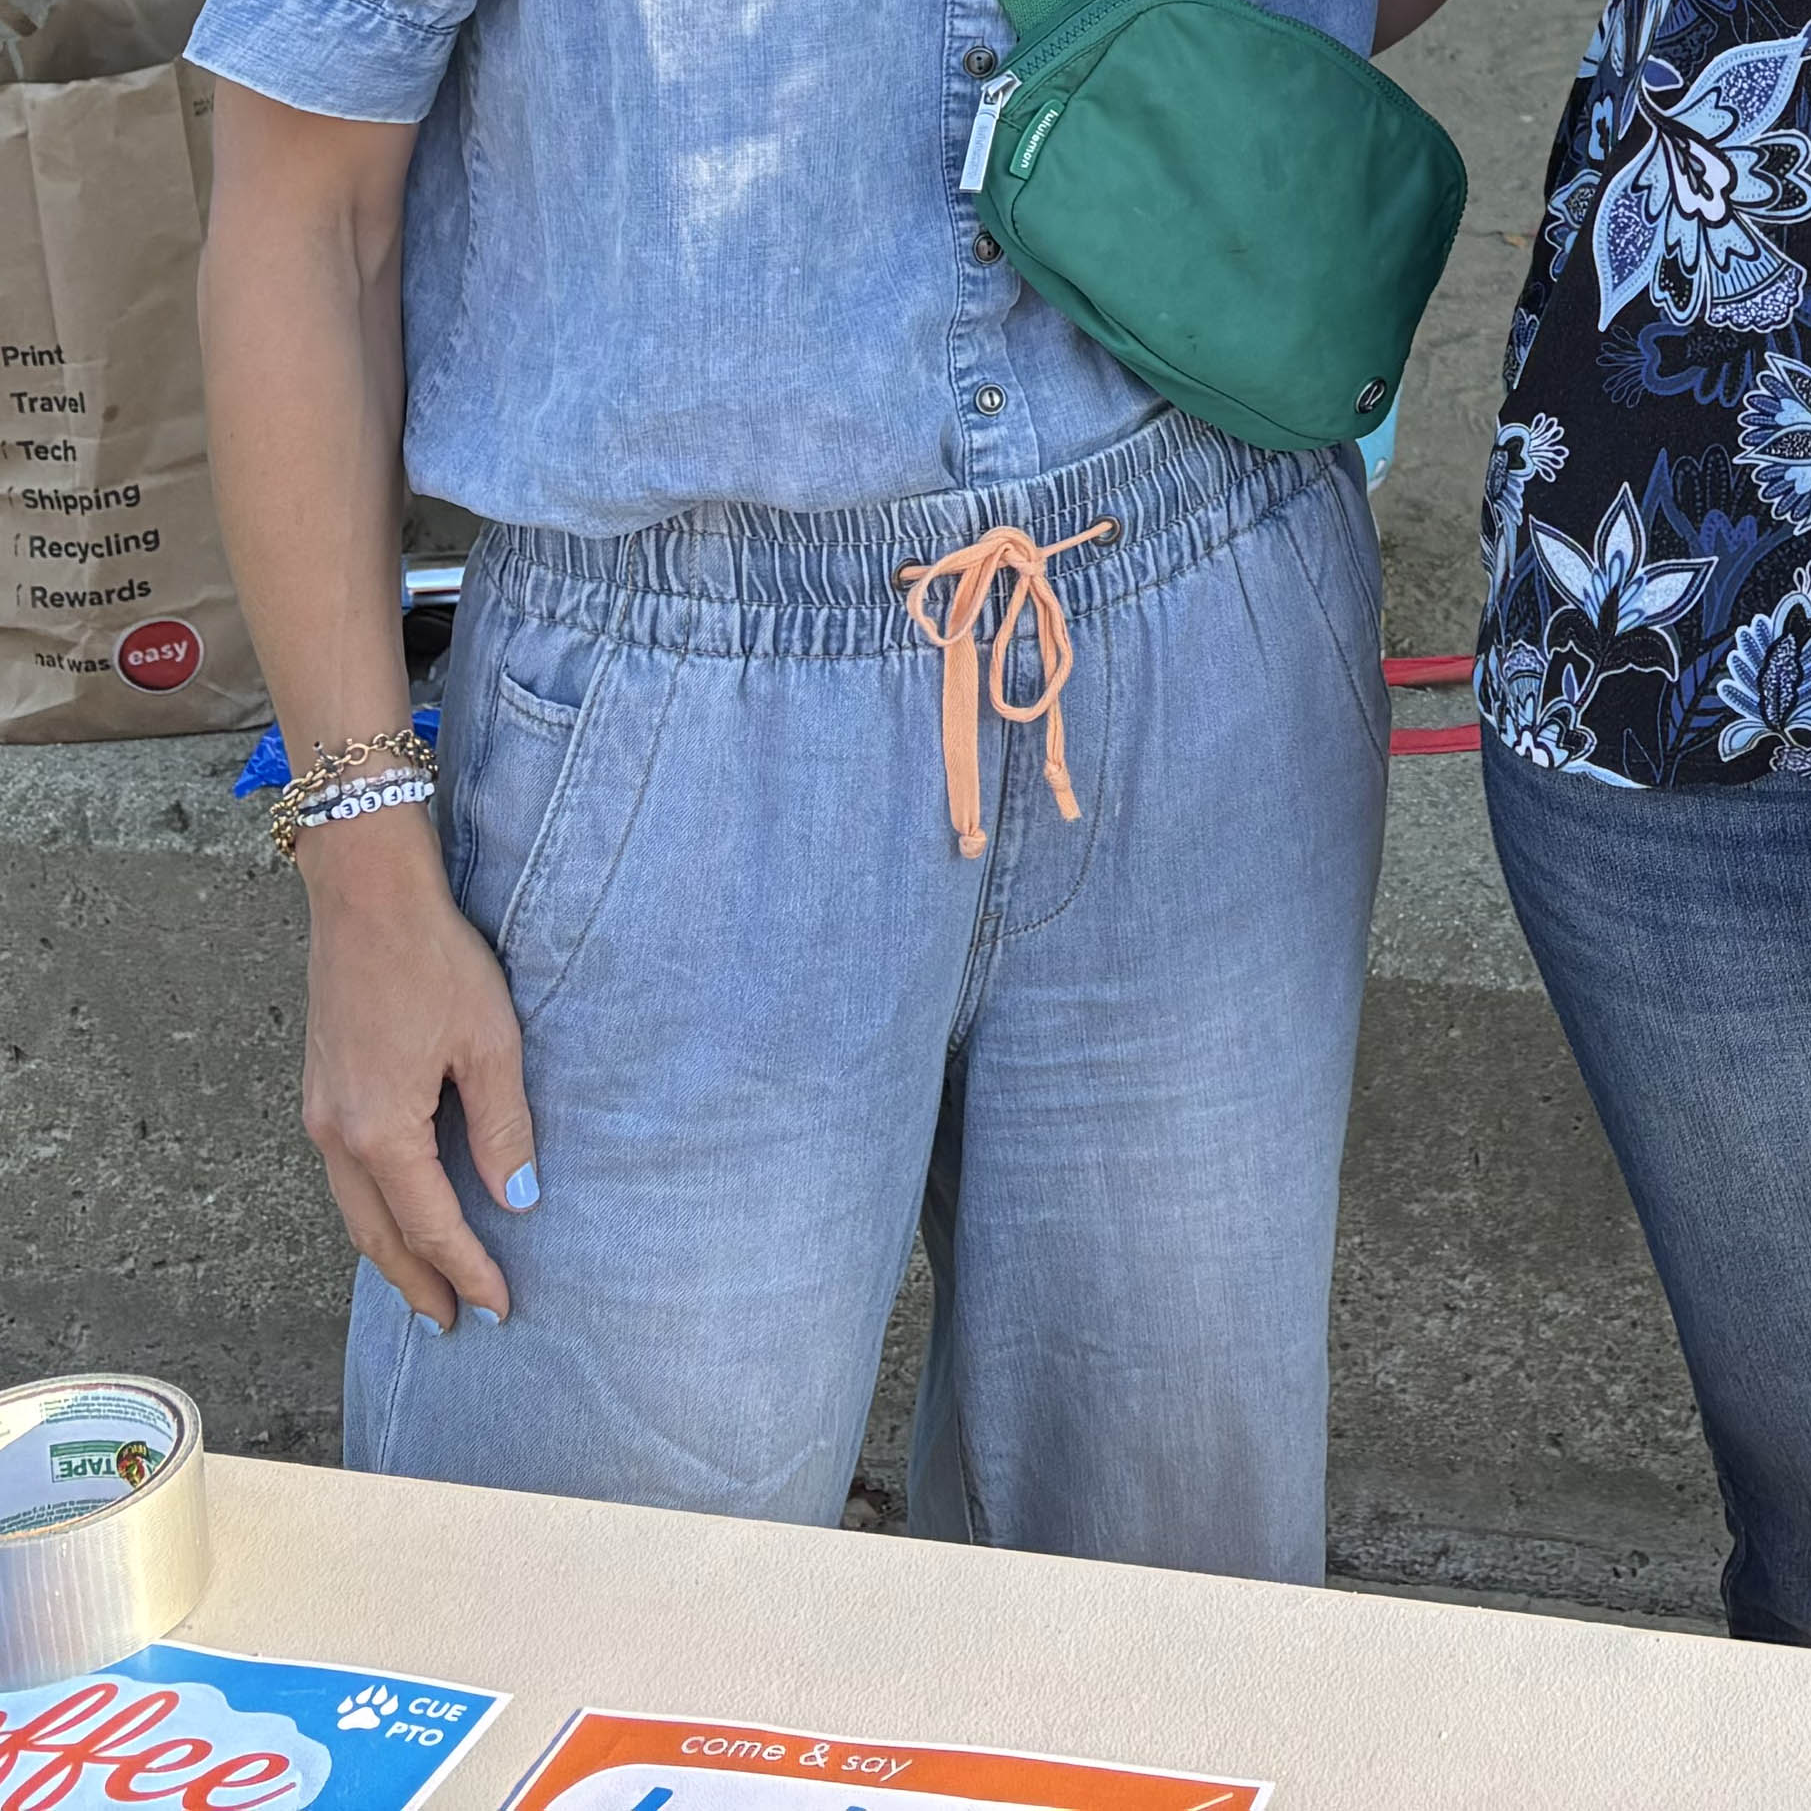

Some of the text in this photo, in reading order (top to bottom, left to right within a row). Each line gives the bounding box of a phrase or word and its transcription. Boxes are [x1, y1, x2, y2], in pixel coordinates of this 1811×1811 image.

[1020, 109, 1060, 169] lululemon
[1, 344, 66, 367] Print
[9, 391, 86, 414] Travel
[15, 439, 77, 462] Tech
[21, 484, 142, 516] Shipping
[28, 528, 161, 564] Recycling
[29, 578, 152, 609] Rewards
[67, 658, 112, 673] was
[128, 640, 188, 667] easy
[58, 1457, 116, 1478] TAPE
[408, 1697, 468, 1722] CUE
[0, 1683, 297, 1811] ffee
[384, 1720, 445, 1747] PTO
[681, 1735, 913, 1782] come & say
